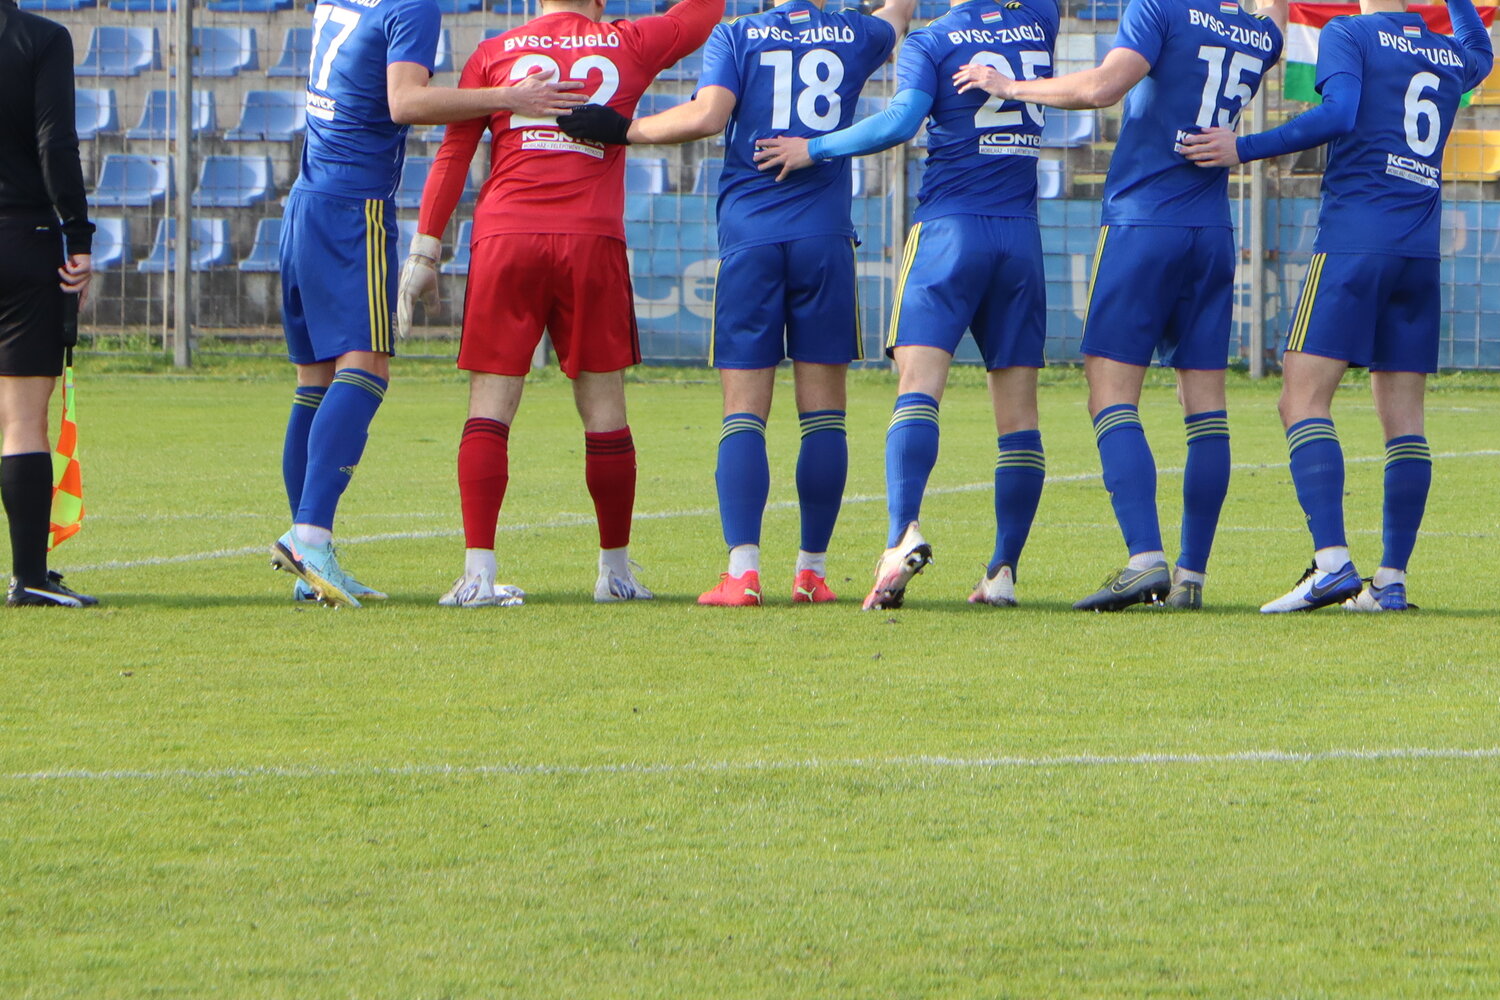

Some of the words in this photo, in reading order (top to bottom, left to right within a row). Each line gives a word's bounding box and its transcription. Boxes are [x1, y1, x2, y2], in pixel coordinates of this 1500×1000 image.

[309, 4, 361, 91] 17
[504, 32, 619, 52] BVSC-ZUGLÓ
[747, 25, 855, 44] BVSC-ZUGLÓ
[948, 22, 1046, 45] BVSC-ZUGLÓ
[1189, 9, 1273, 52] BVSC-ZUGLÓ
[760, 50, 844, 131] 18
[1196, 45, 1263, 132] 15
[1404, 72, 1441, 157] 6
